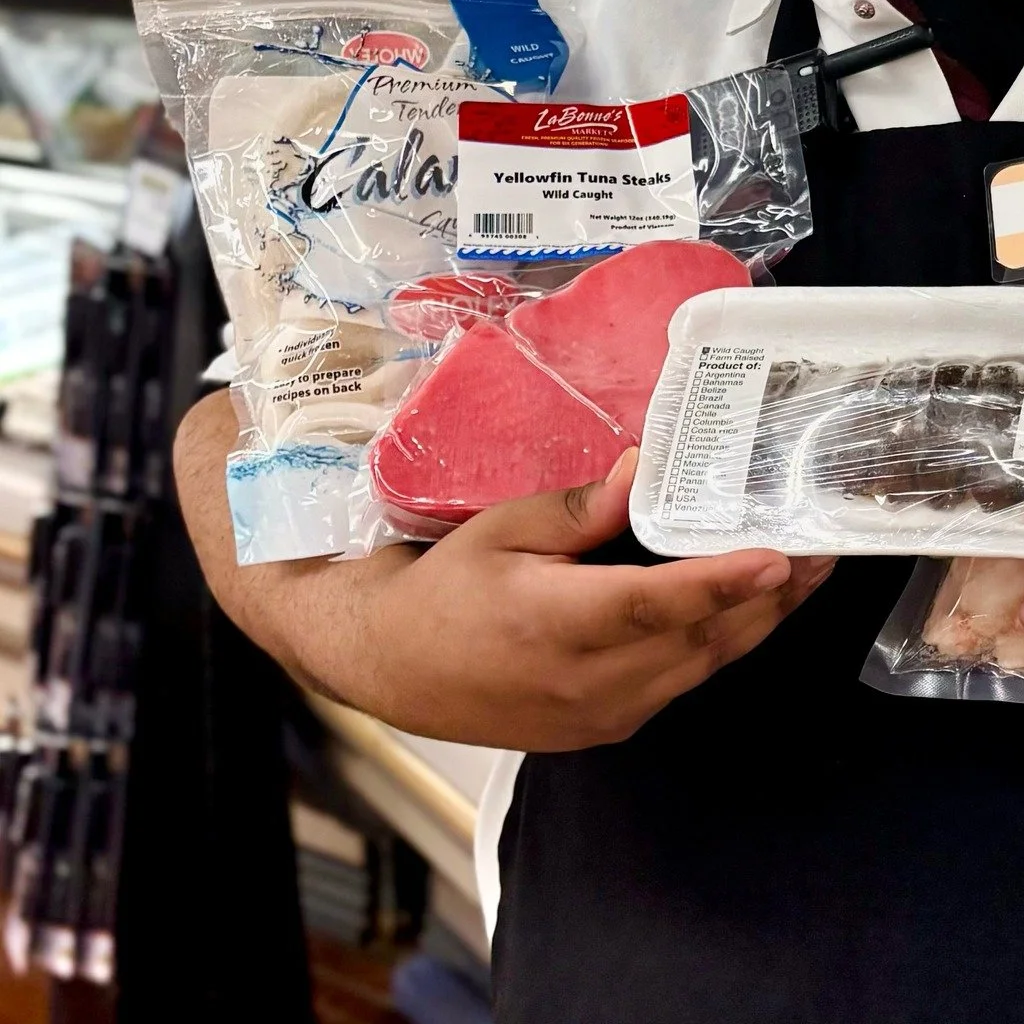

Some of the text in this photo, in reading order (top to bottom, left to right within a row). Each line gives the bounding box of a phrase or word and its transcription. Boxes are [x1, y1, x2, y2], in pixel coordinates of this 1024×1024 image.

[510, 43, 539, 53] WILD
[367, 75, 477, 95] Premium
[391, 97, 458, 122] Tende
[571, 128, 614, 136] MARKETS
[494, 172, 671, 186] Yellowfin Tuna Steaks
[543, 190, 613, 201] Wild Caught
[733, 347, 764, 355] Caught
[281, 351, 306, 365] quick
[698, 362, 761, 370] Product of:
[298, 368, 361, 383] to prepare
[704, 371, 746, 379] Argentina
[272, 381, 362, 403] recipes on back
[689, 435, 720, 443] Ecuad
[679, 477, 708, 485] Pana
[677, 486, 699, 494] Peru
